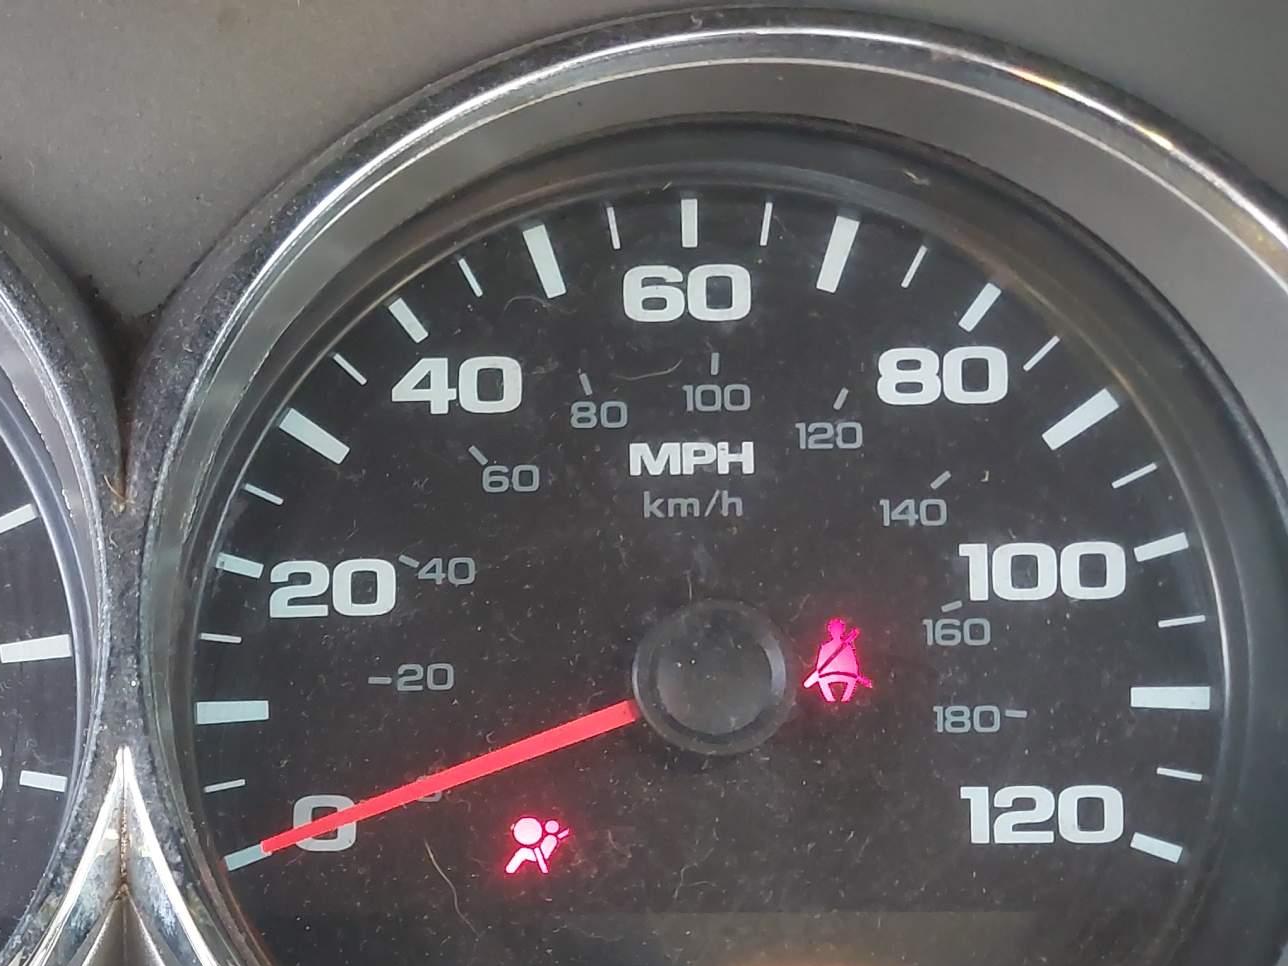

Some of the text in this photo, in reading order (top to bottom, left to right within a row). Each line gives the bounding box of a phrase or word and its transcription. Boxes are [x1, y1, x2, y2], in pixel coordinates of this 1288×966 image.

[623, 264, 751, 322] 60
[392, 355, 522, 414] 40
[877, 347, 1008, 405] 80
[683, 384, 750, 412] 100
[570, 401, 628, 429] 80
[795, 422, 863, 449] 120
[629, 442, 754, 476] MPH
[482, 465, 540, 493] 60
[644, 491, 743, 518] km/h
[880, 498, 947, 527] 140
[417, 557, 475, 585] 40
[959, 541, 1126, 601] 100
[269, 559, 396, 618] 20
[924, 618, 991, 647] 160
[933, 705, 1000, 733] 180
[293, 794, 357, 851] 0
[960, 785, 1124, 844] 120
